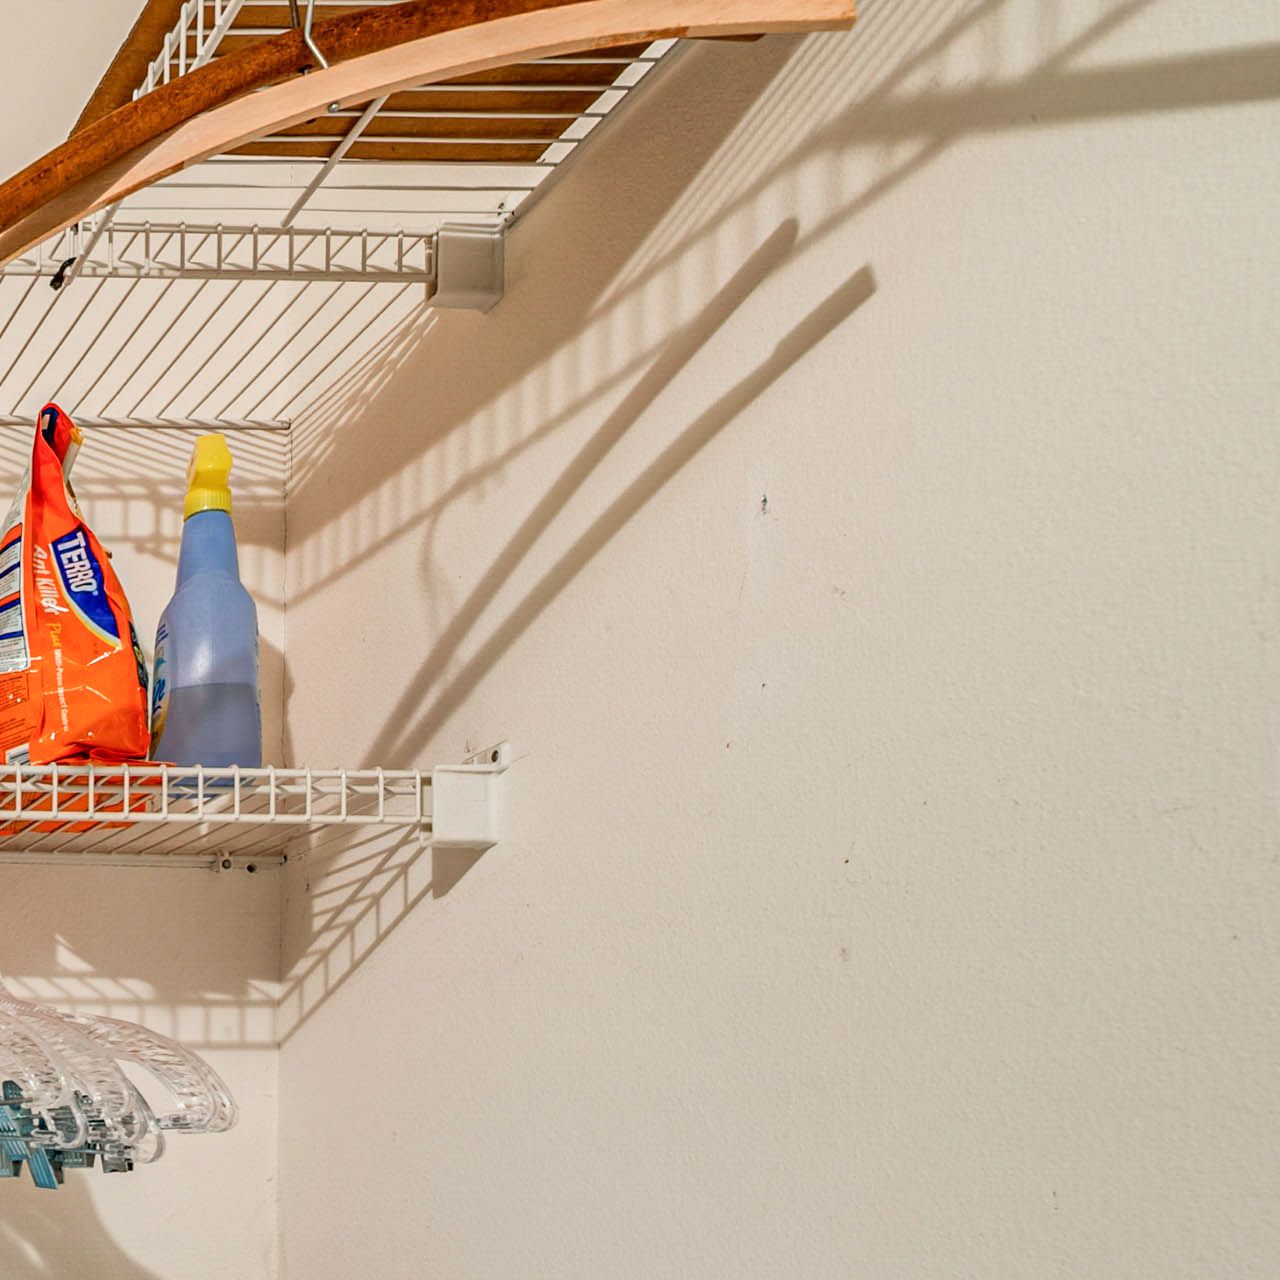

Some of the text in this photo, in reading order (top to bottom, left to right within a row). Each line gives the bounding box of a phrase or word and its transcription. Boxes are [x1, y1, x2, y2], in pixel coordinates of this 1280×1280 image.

[33, 544, 63, 615] Ant Killer
[57, 531, 97, 593] TERRO
